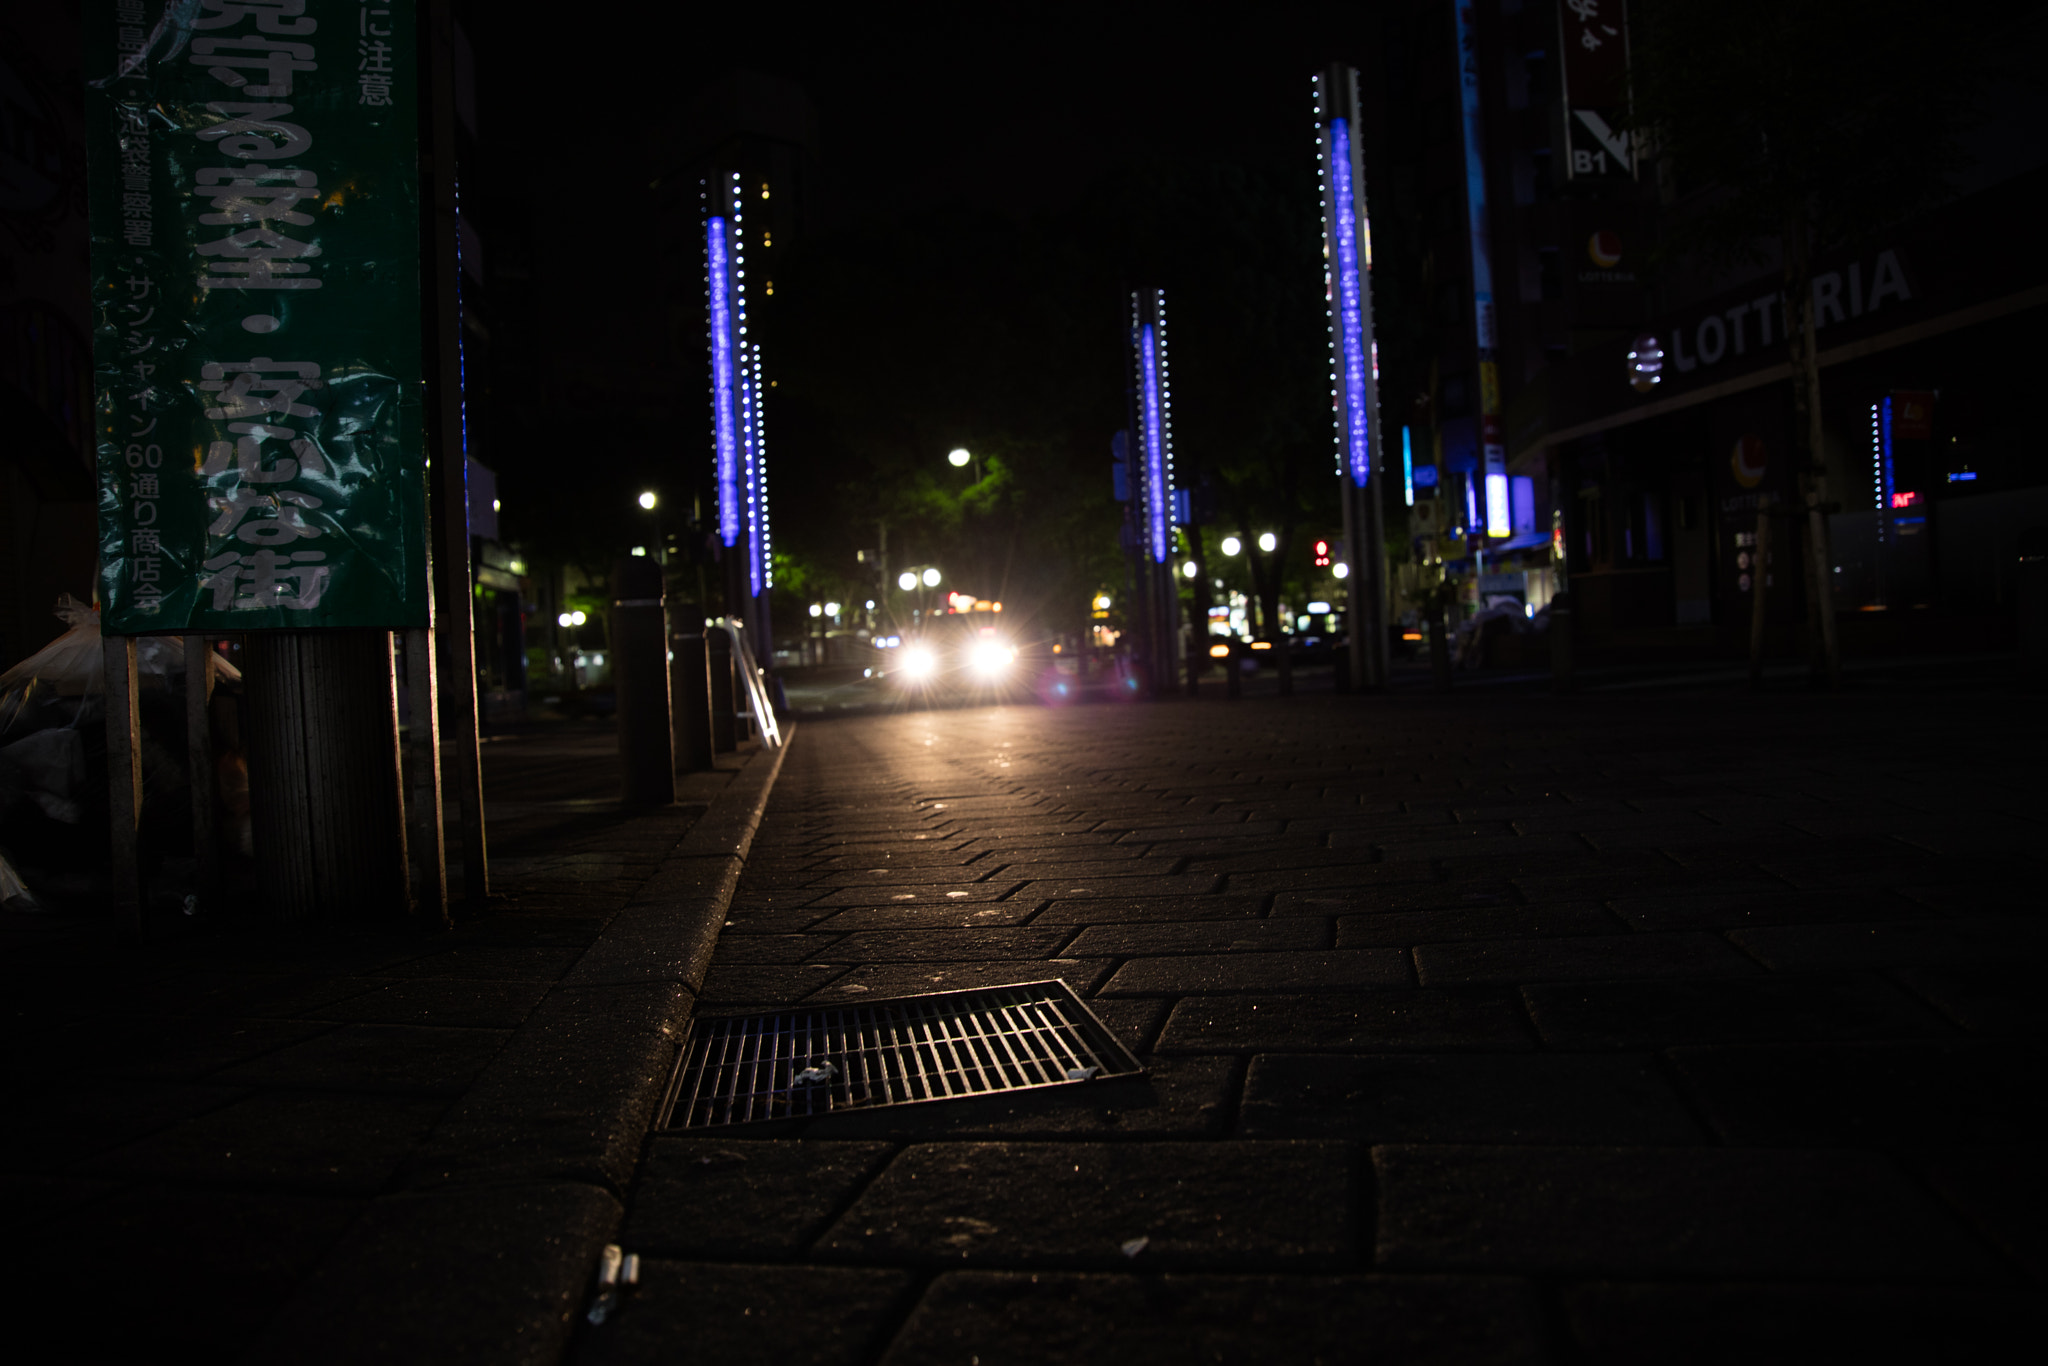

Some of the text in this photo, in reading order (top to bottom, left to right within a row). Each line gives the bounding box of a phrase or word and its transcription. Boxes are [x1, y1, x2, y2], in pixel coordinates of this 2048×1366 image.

[357, 0, 394, 107] に注意
[1573, 149, 1607, 175] B1
